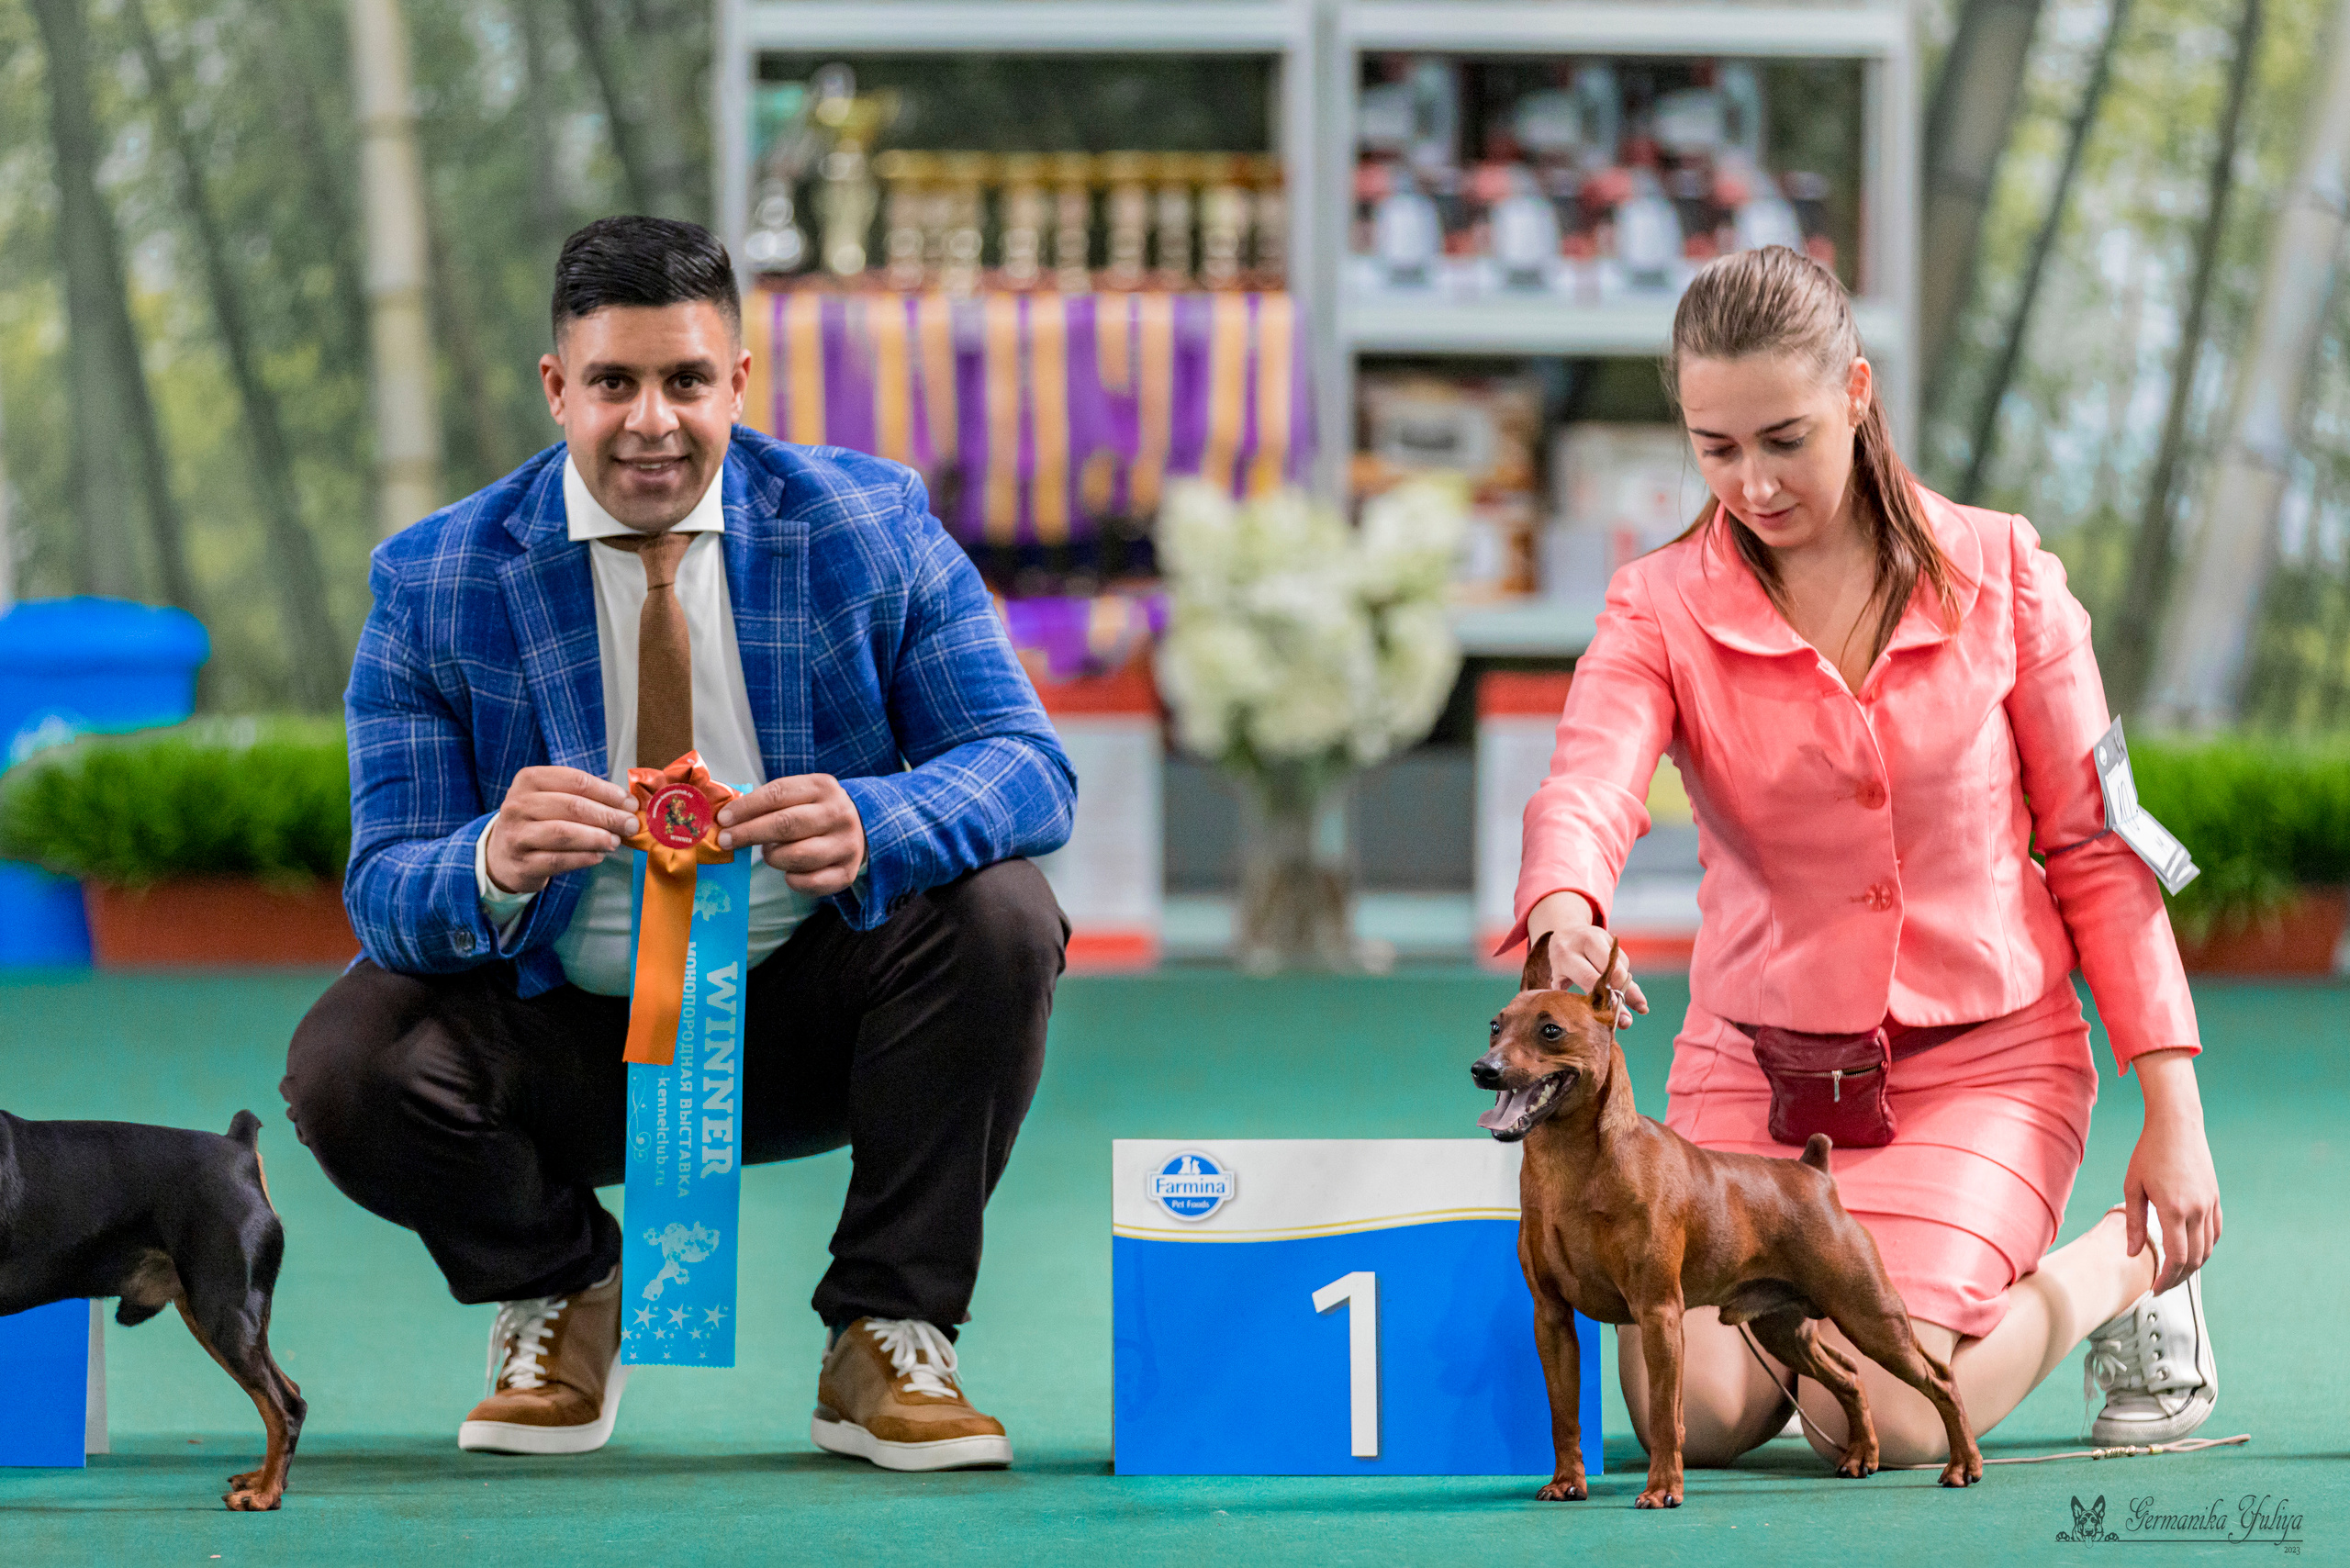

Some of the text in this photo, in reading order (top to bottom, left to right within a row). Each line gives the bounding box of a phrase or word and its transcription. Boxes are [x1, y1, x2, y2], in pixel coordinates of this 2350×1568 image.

[670, 834, 692, 844] WINNER
[700, 960, 738, 1180] WINNER
[677, 1098, 693, 1198] ВЫСТАВКА
[1156, 1177, 1225, 1193] Farmina
[1171, 1199, 1211, 1209] Pet Foods
[1311, 1271, 1379, 1458] 1
